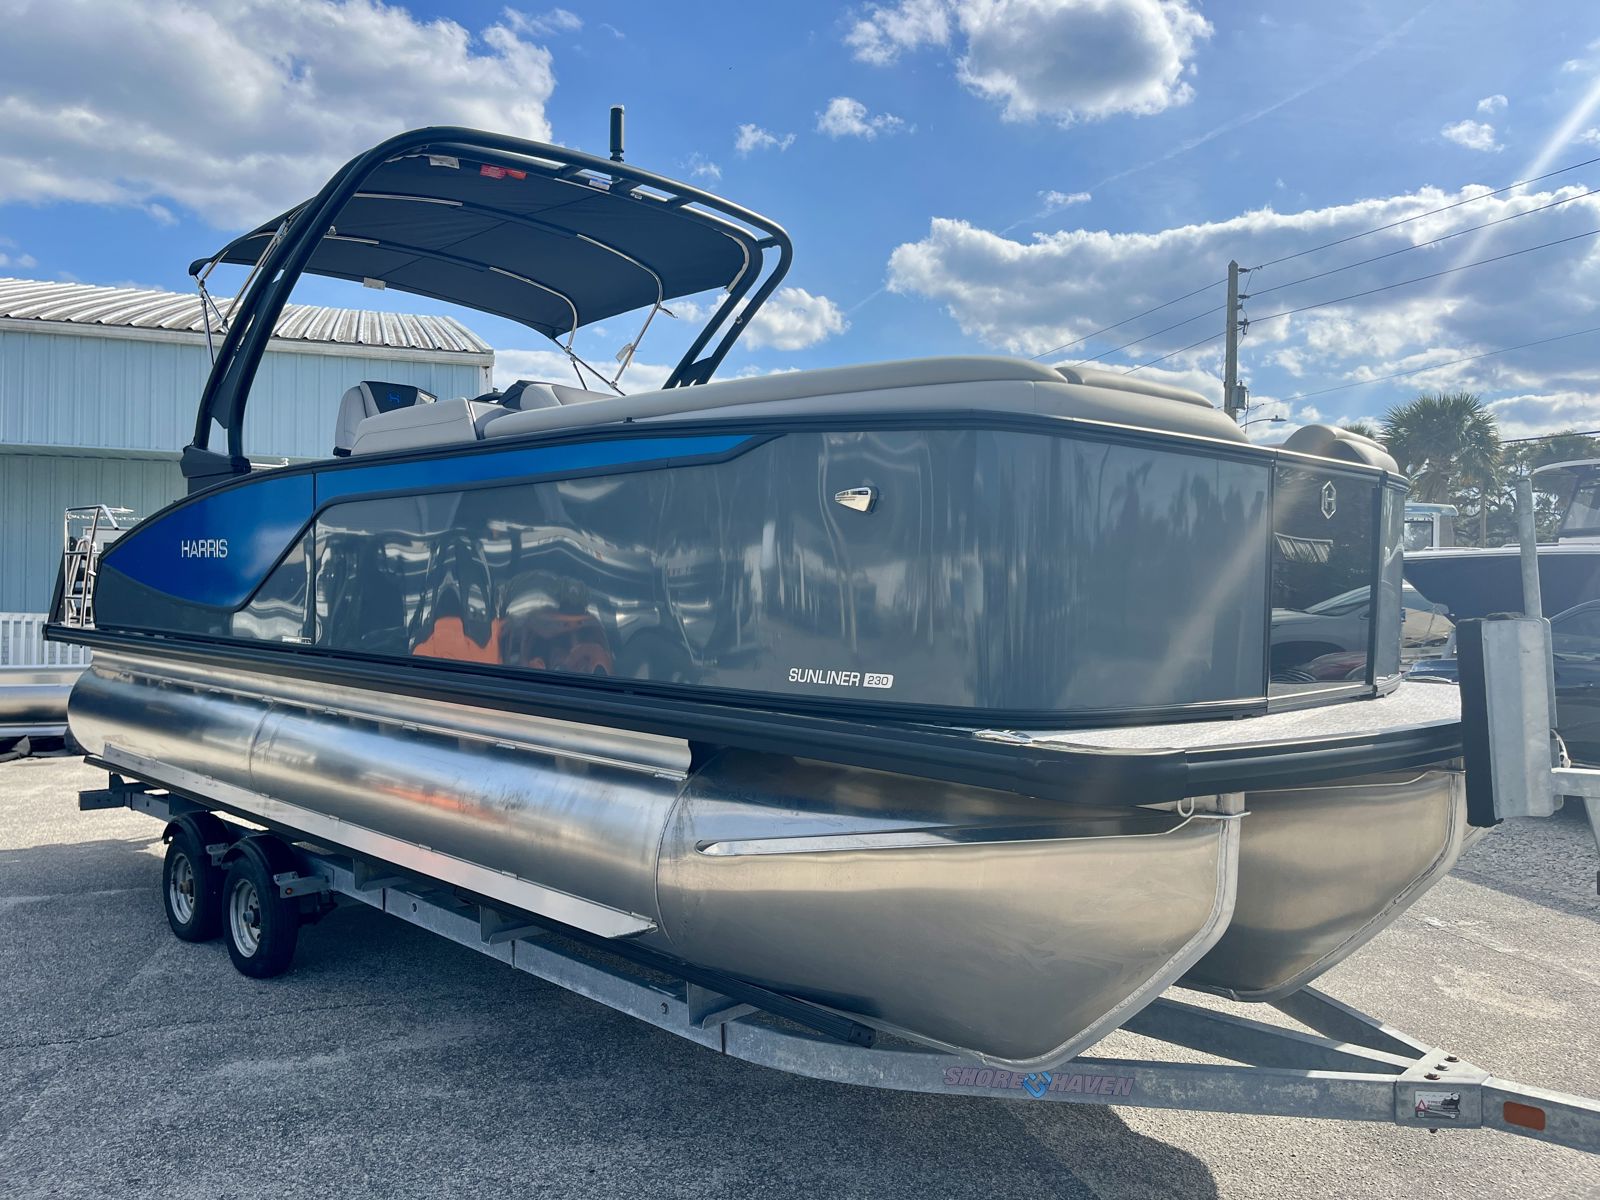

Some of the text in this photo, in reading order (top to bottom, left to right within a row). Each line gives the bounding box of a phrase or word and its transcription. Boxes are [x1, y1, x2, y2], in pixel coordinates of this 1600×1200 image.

[181, 538, 228, 558] HARRIS
[788, 667, 890, 687] SUNLINER 230
[943, 1066, 1136, 1097] SHORE HAVEN
